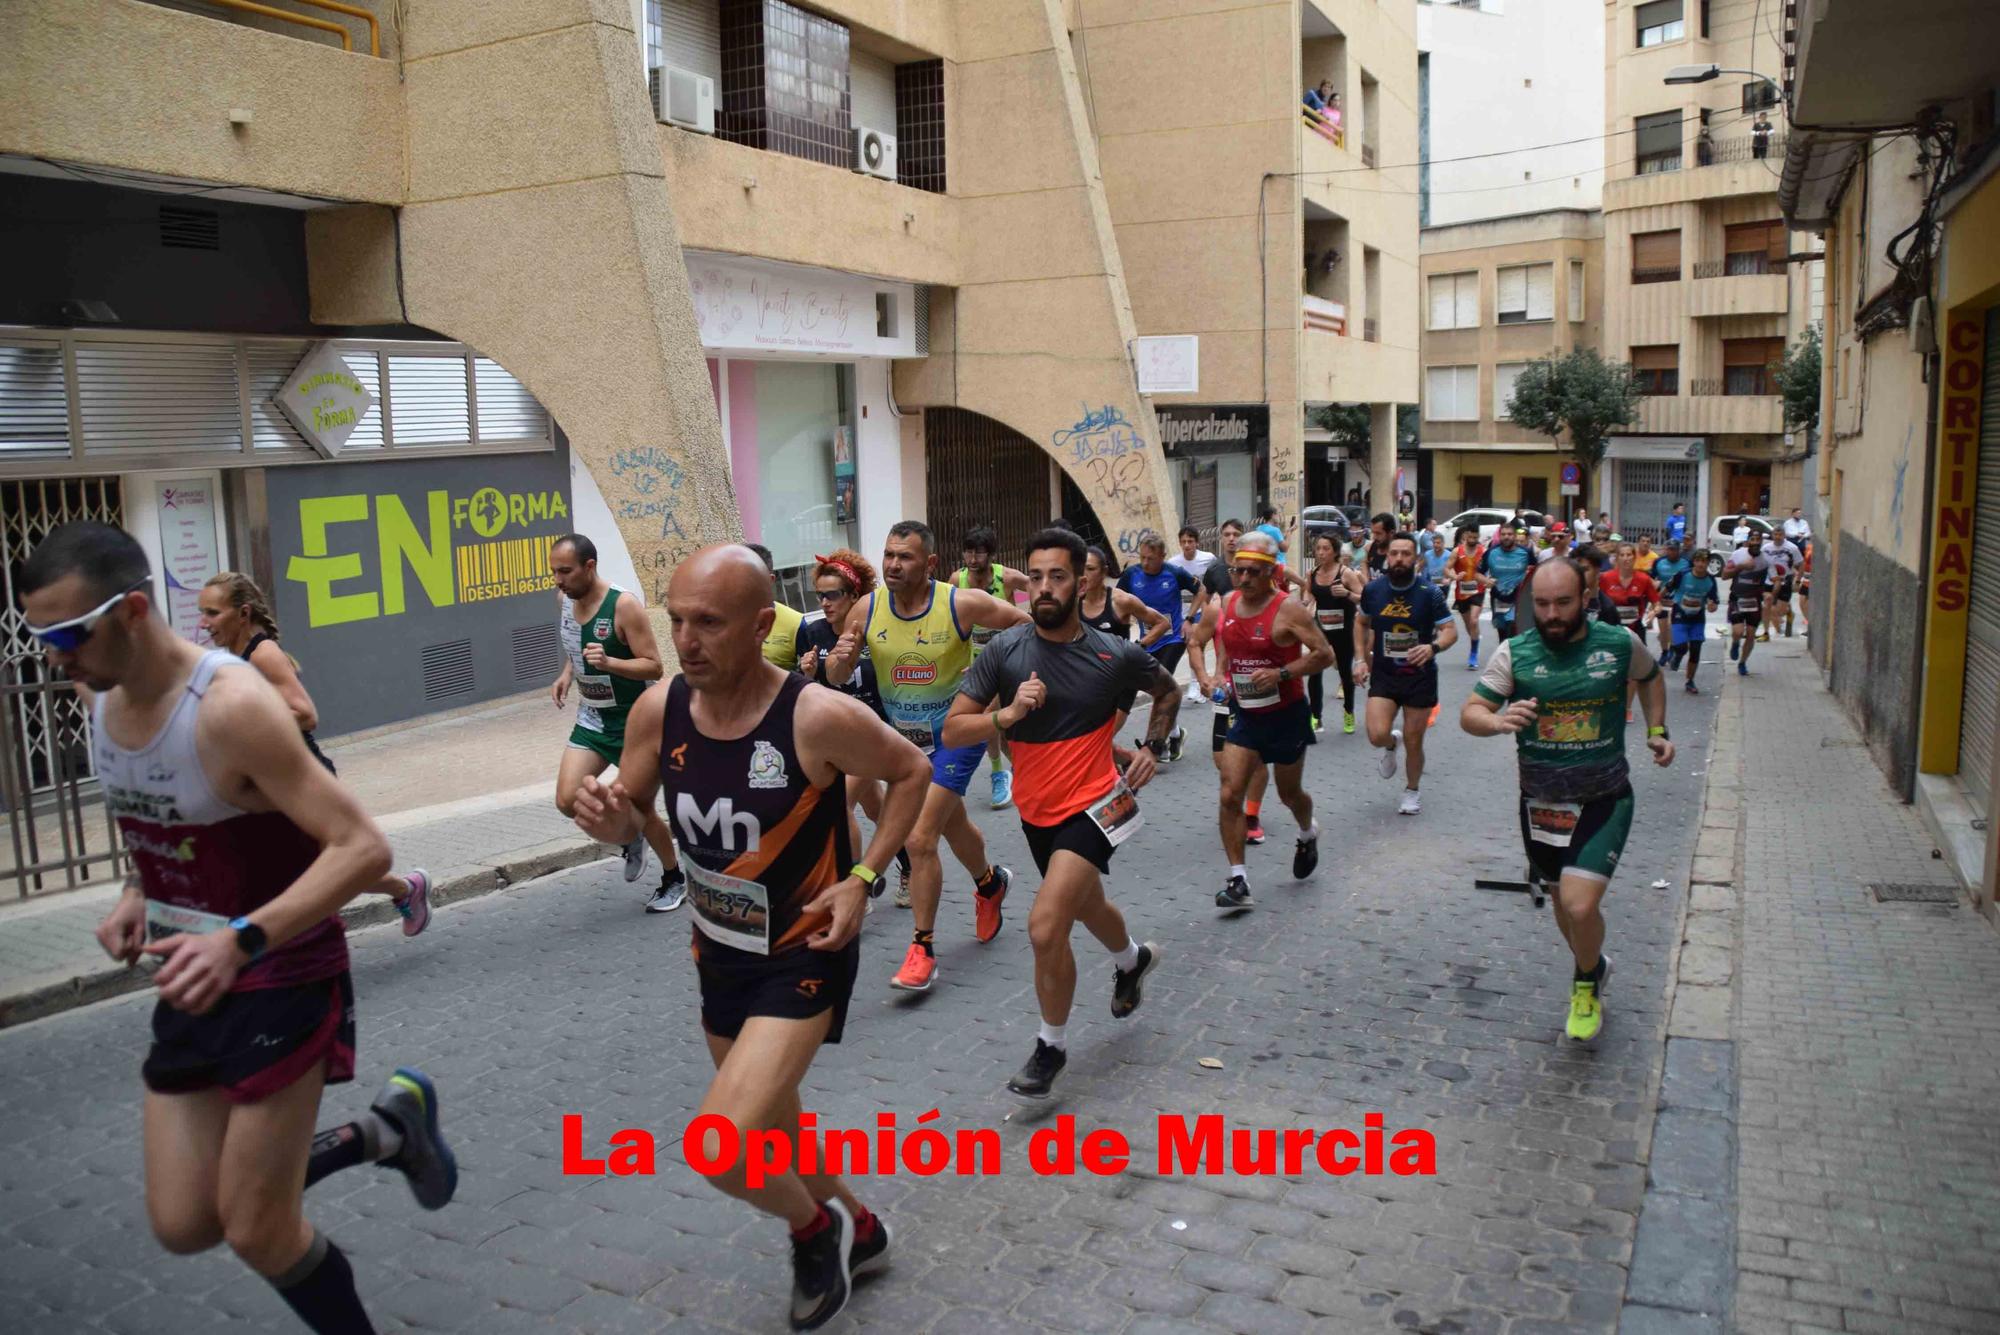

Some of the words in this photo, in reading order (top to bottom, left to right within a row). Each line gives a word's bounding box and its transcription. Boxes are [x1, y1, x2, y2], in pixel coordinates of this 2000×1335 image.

[1157, 412, 1249, 450] Hipercalzados
[1936, 320, 1981, 612] CORTINAS
[286, 490, 455, 628] EN
[453, 487, 567, 537] FORMA
[467, 582, 510, 602] DESDE
[896, 669, 905, 679] El
[907, 668, 933, 679] Llano
[904, 704, 919, 712] DE
[676, 792, 760, 853] Mh
